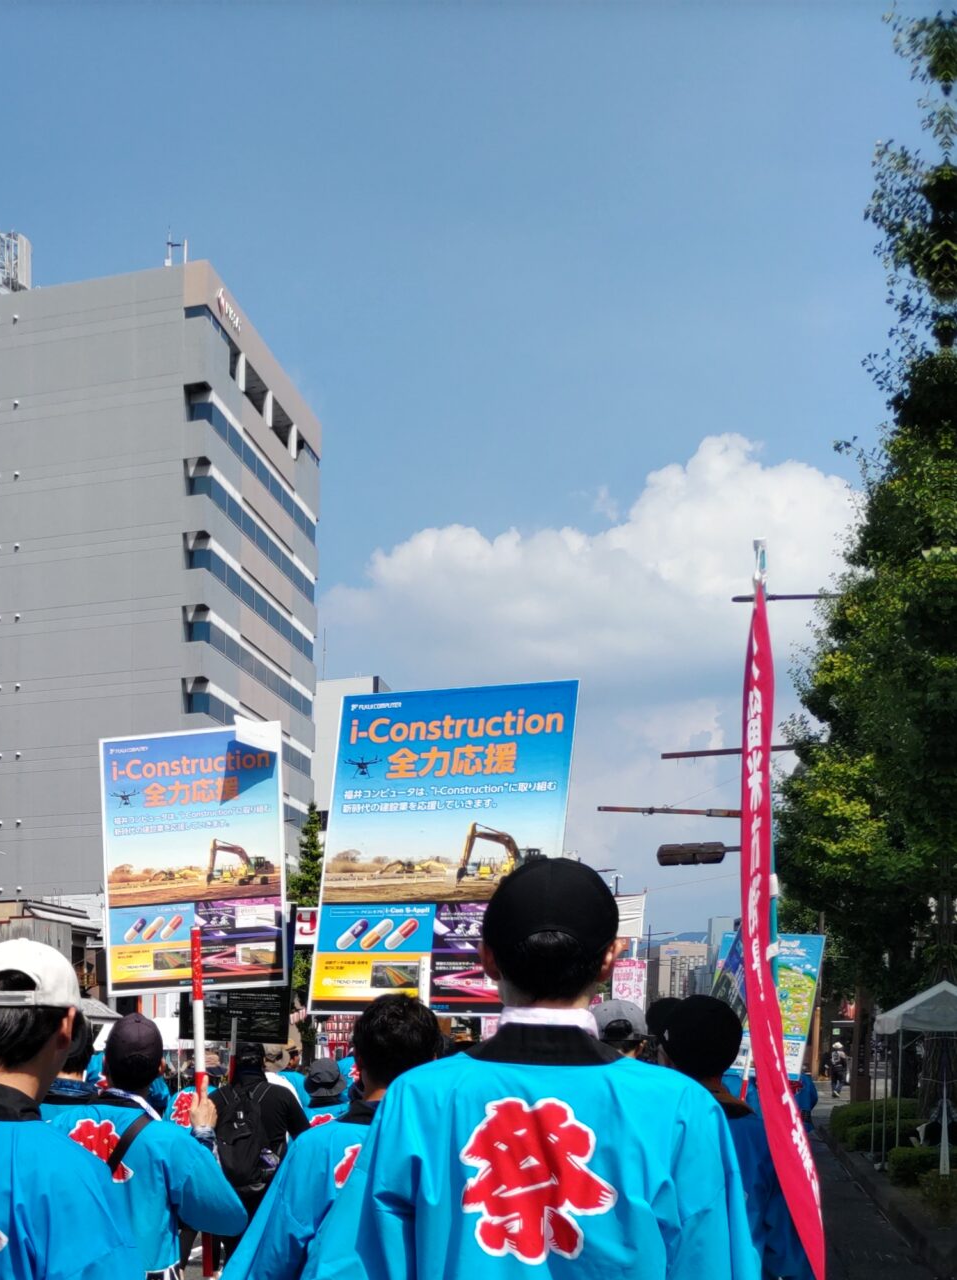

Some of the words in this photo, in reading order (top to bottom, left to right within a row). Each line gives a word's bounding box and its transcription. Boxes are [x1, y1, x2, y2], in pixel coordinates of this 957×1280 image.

[349, 708, 565, 745] i-Construction
[111, 750, 270, 781] i-Construction
[386, 742, 517, 779] 全力応援
[143, 776, 239, 807] 全力応援
[459, 1096, 619, 1265] 祭
